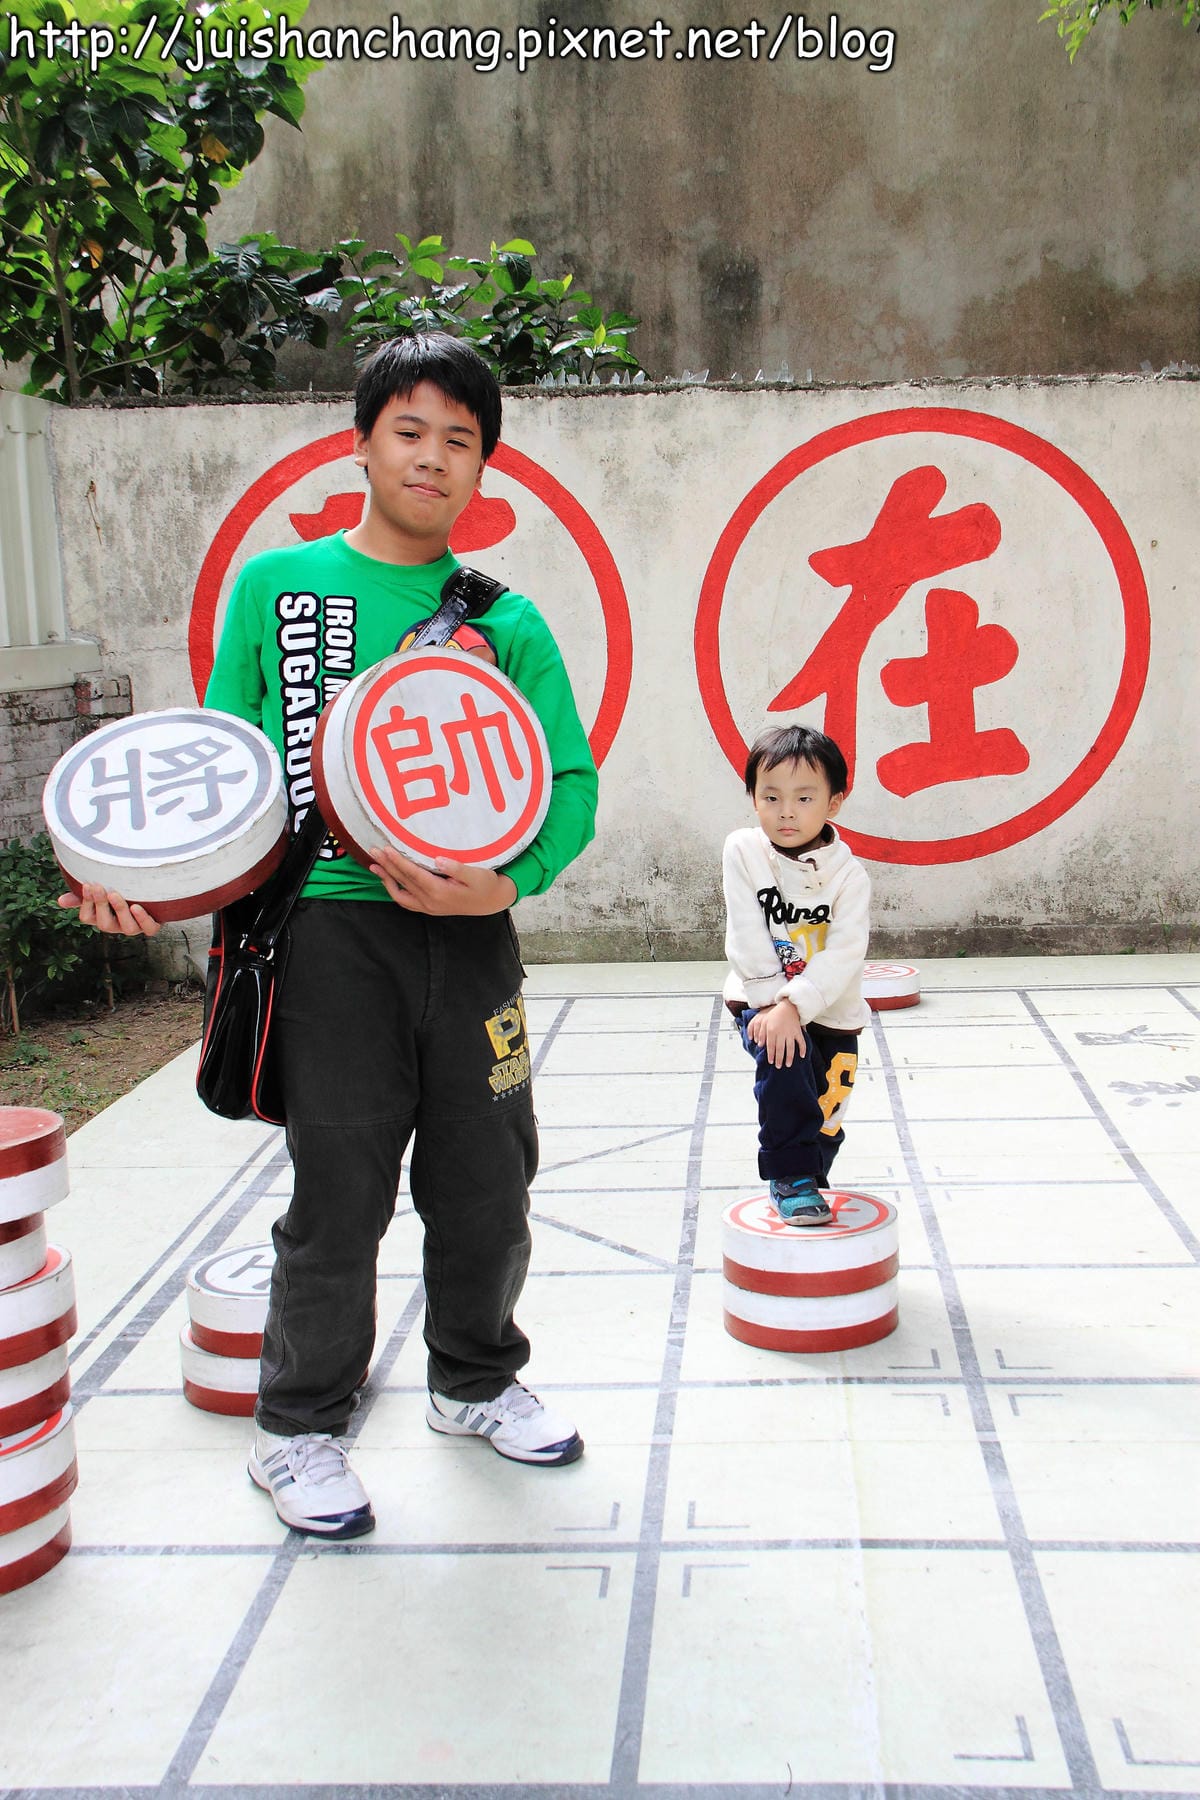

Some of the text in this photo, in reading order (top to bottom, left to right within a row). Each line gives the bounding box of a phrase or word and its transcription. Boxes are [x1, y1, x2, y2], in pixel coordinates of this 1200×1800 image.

[325, 597, 354, 672] IRON
[767, 464, 1031, 798] 在
[88, 735, 249, 836] 將
[370, 692, 525, 820] 帥
[488, 1063, 530, 1094] WARS
[491, 1052, 529, 1081] STAR
